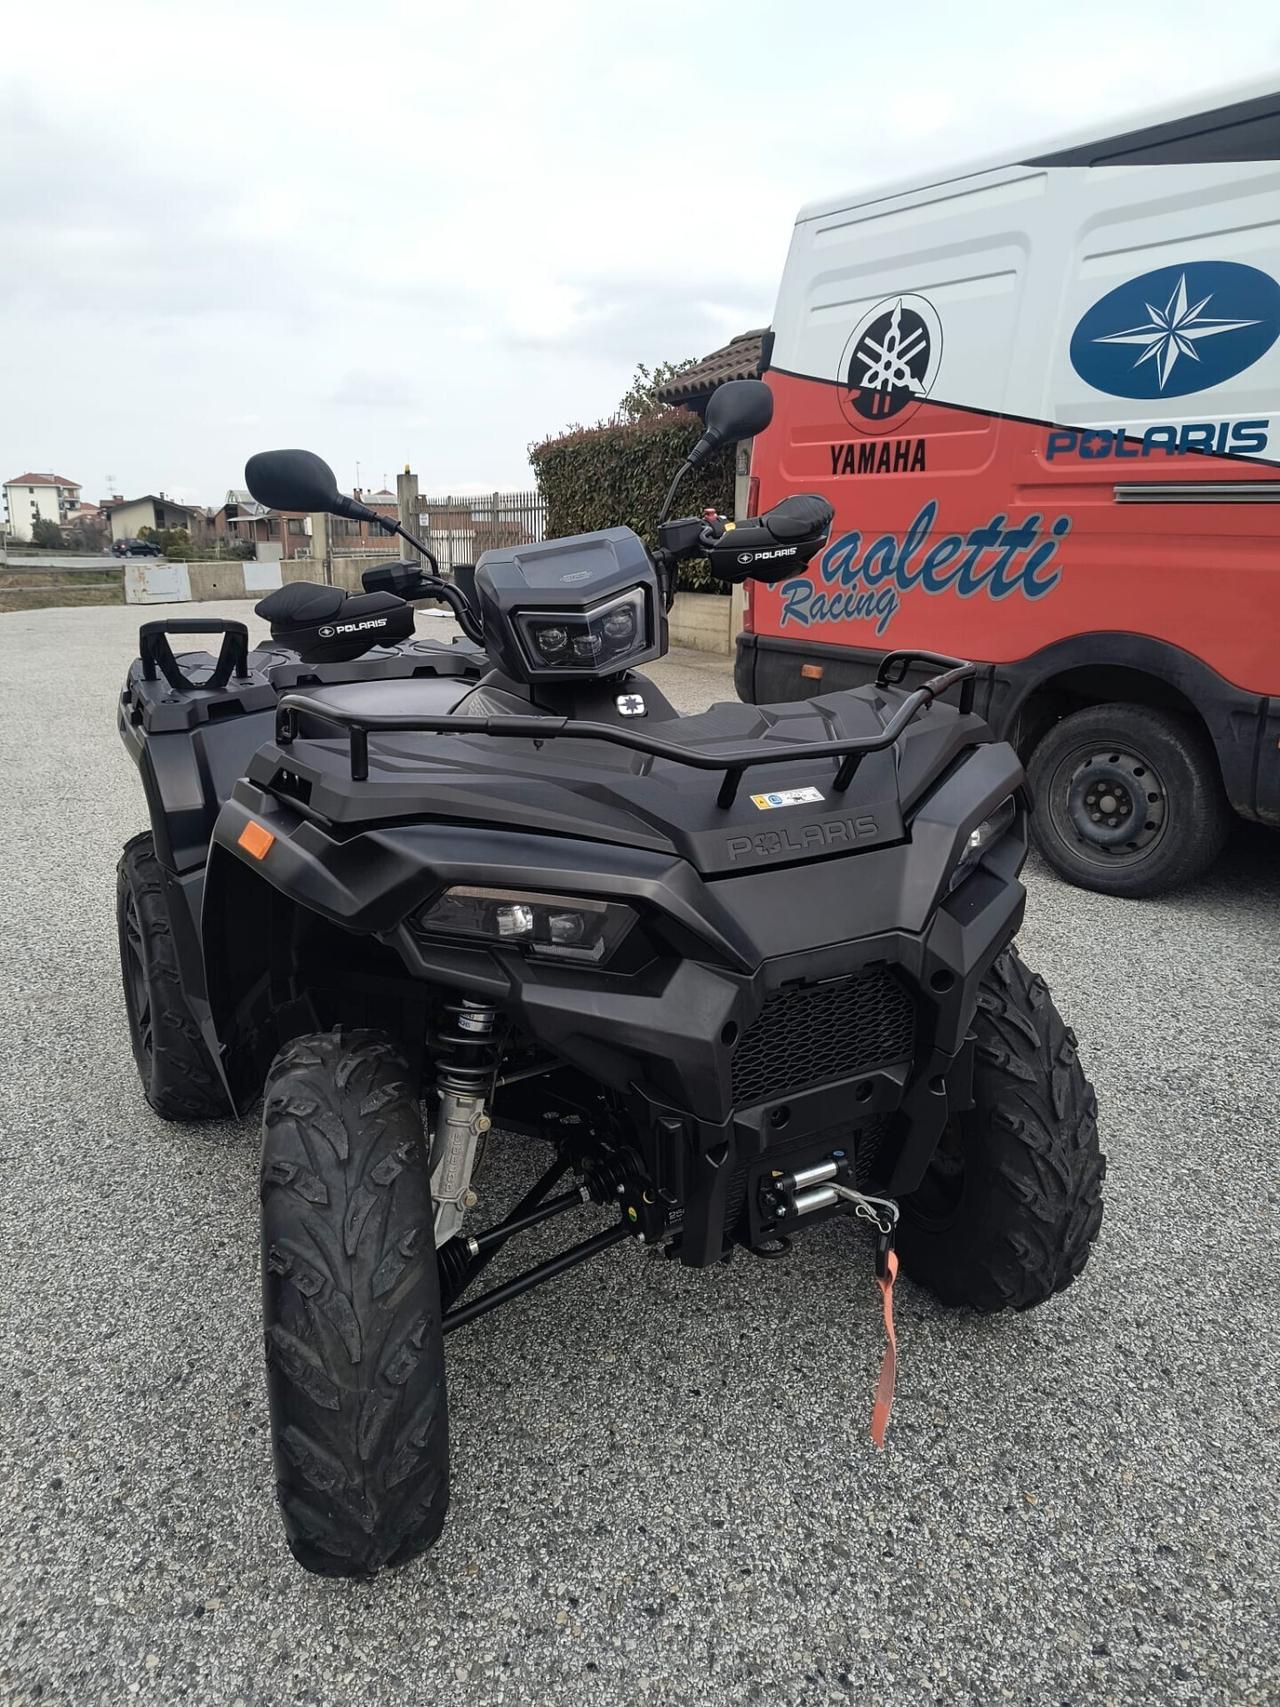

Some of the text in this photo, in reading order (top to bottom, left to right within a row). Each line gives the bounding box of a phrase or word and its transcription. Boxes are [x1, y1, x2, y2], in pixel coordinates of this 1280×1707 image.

[830, 438, 926, 475] YAMAHA
[1046, 419, 1270, 461] POLARIS
[754, 547, 797, 561] POLARIS
[768, 496, 1072, 601] aoletti
[336, 618, 388, 634] POLARIS
[781, 579, 899, 636] Racing
[726, 815, 879, 861] POLARIS
